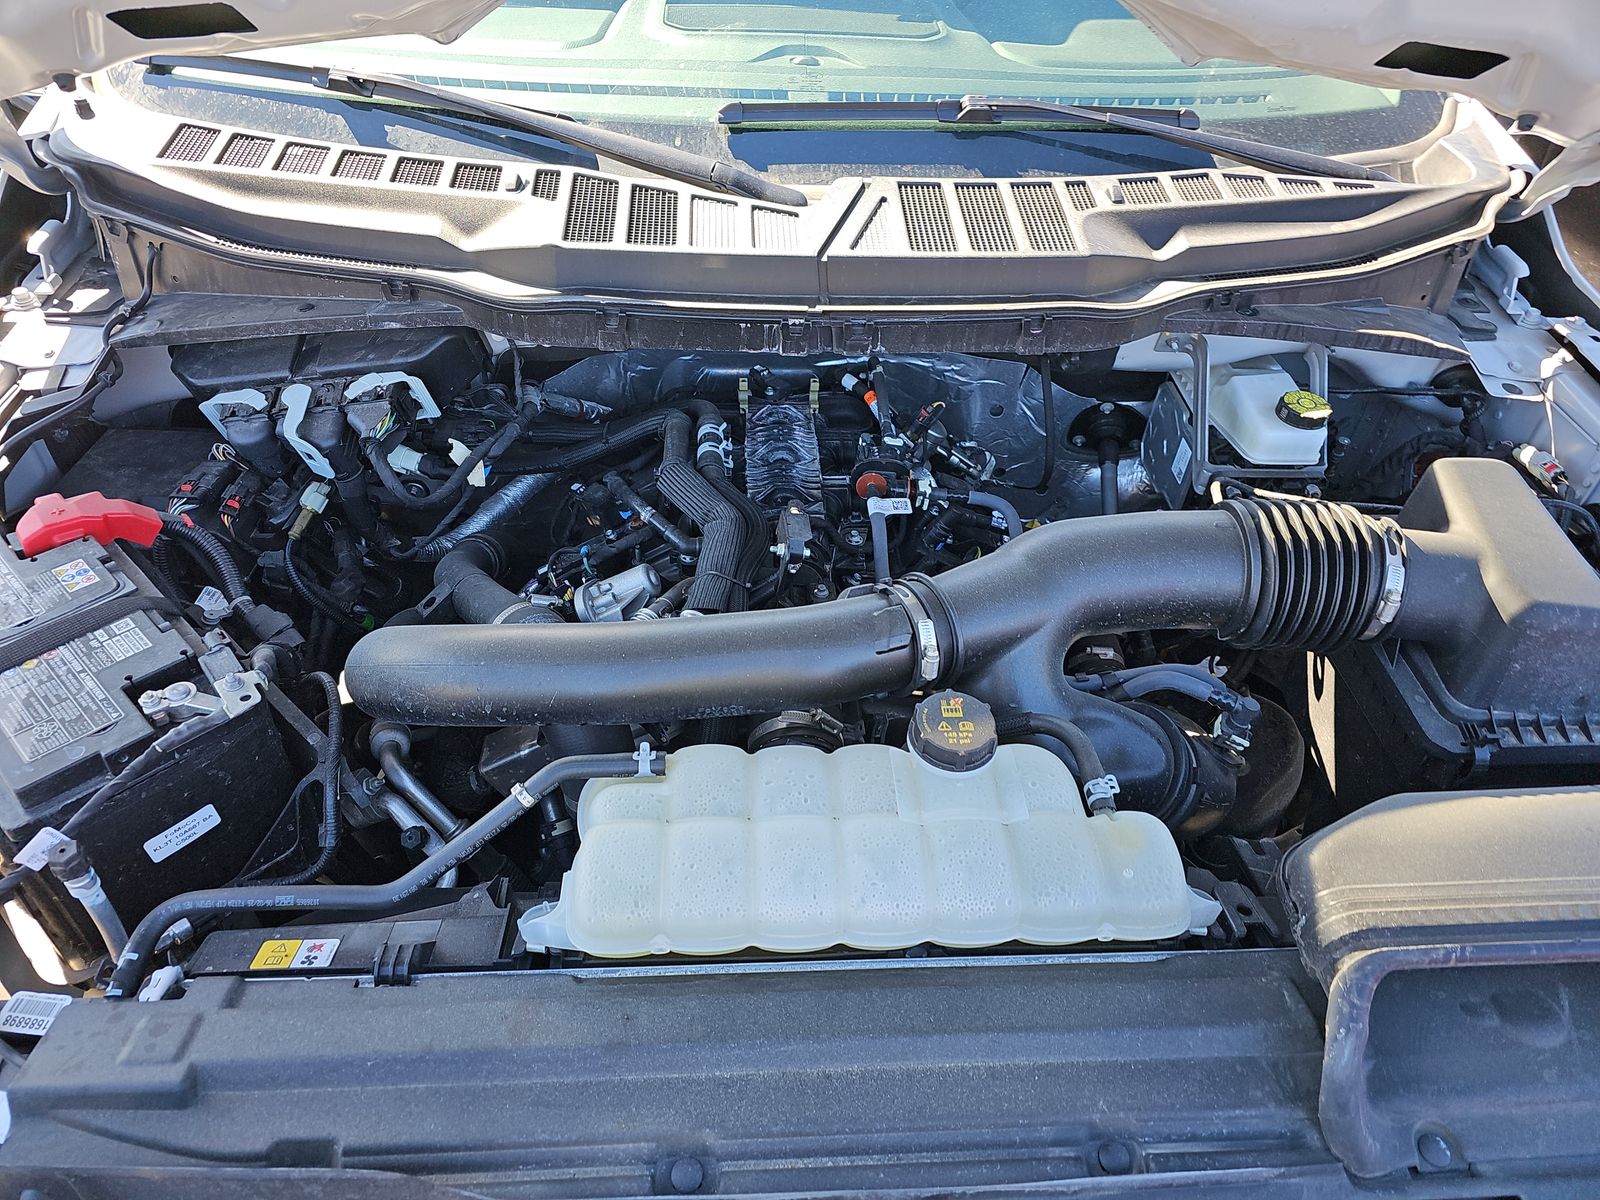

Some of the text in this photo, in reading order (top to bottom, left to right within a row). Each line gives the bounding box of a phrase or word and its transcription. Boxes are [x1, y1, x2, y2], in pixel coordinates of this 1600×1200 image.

[164, 819, 197, 839] FoMoCo
[153, 838, 173, 852] KL3T
[2, 1014, 49, 1031] 1686898
